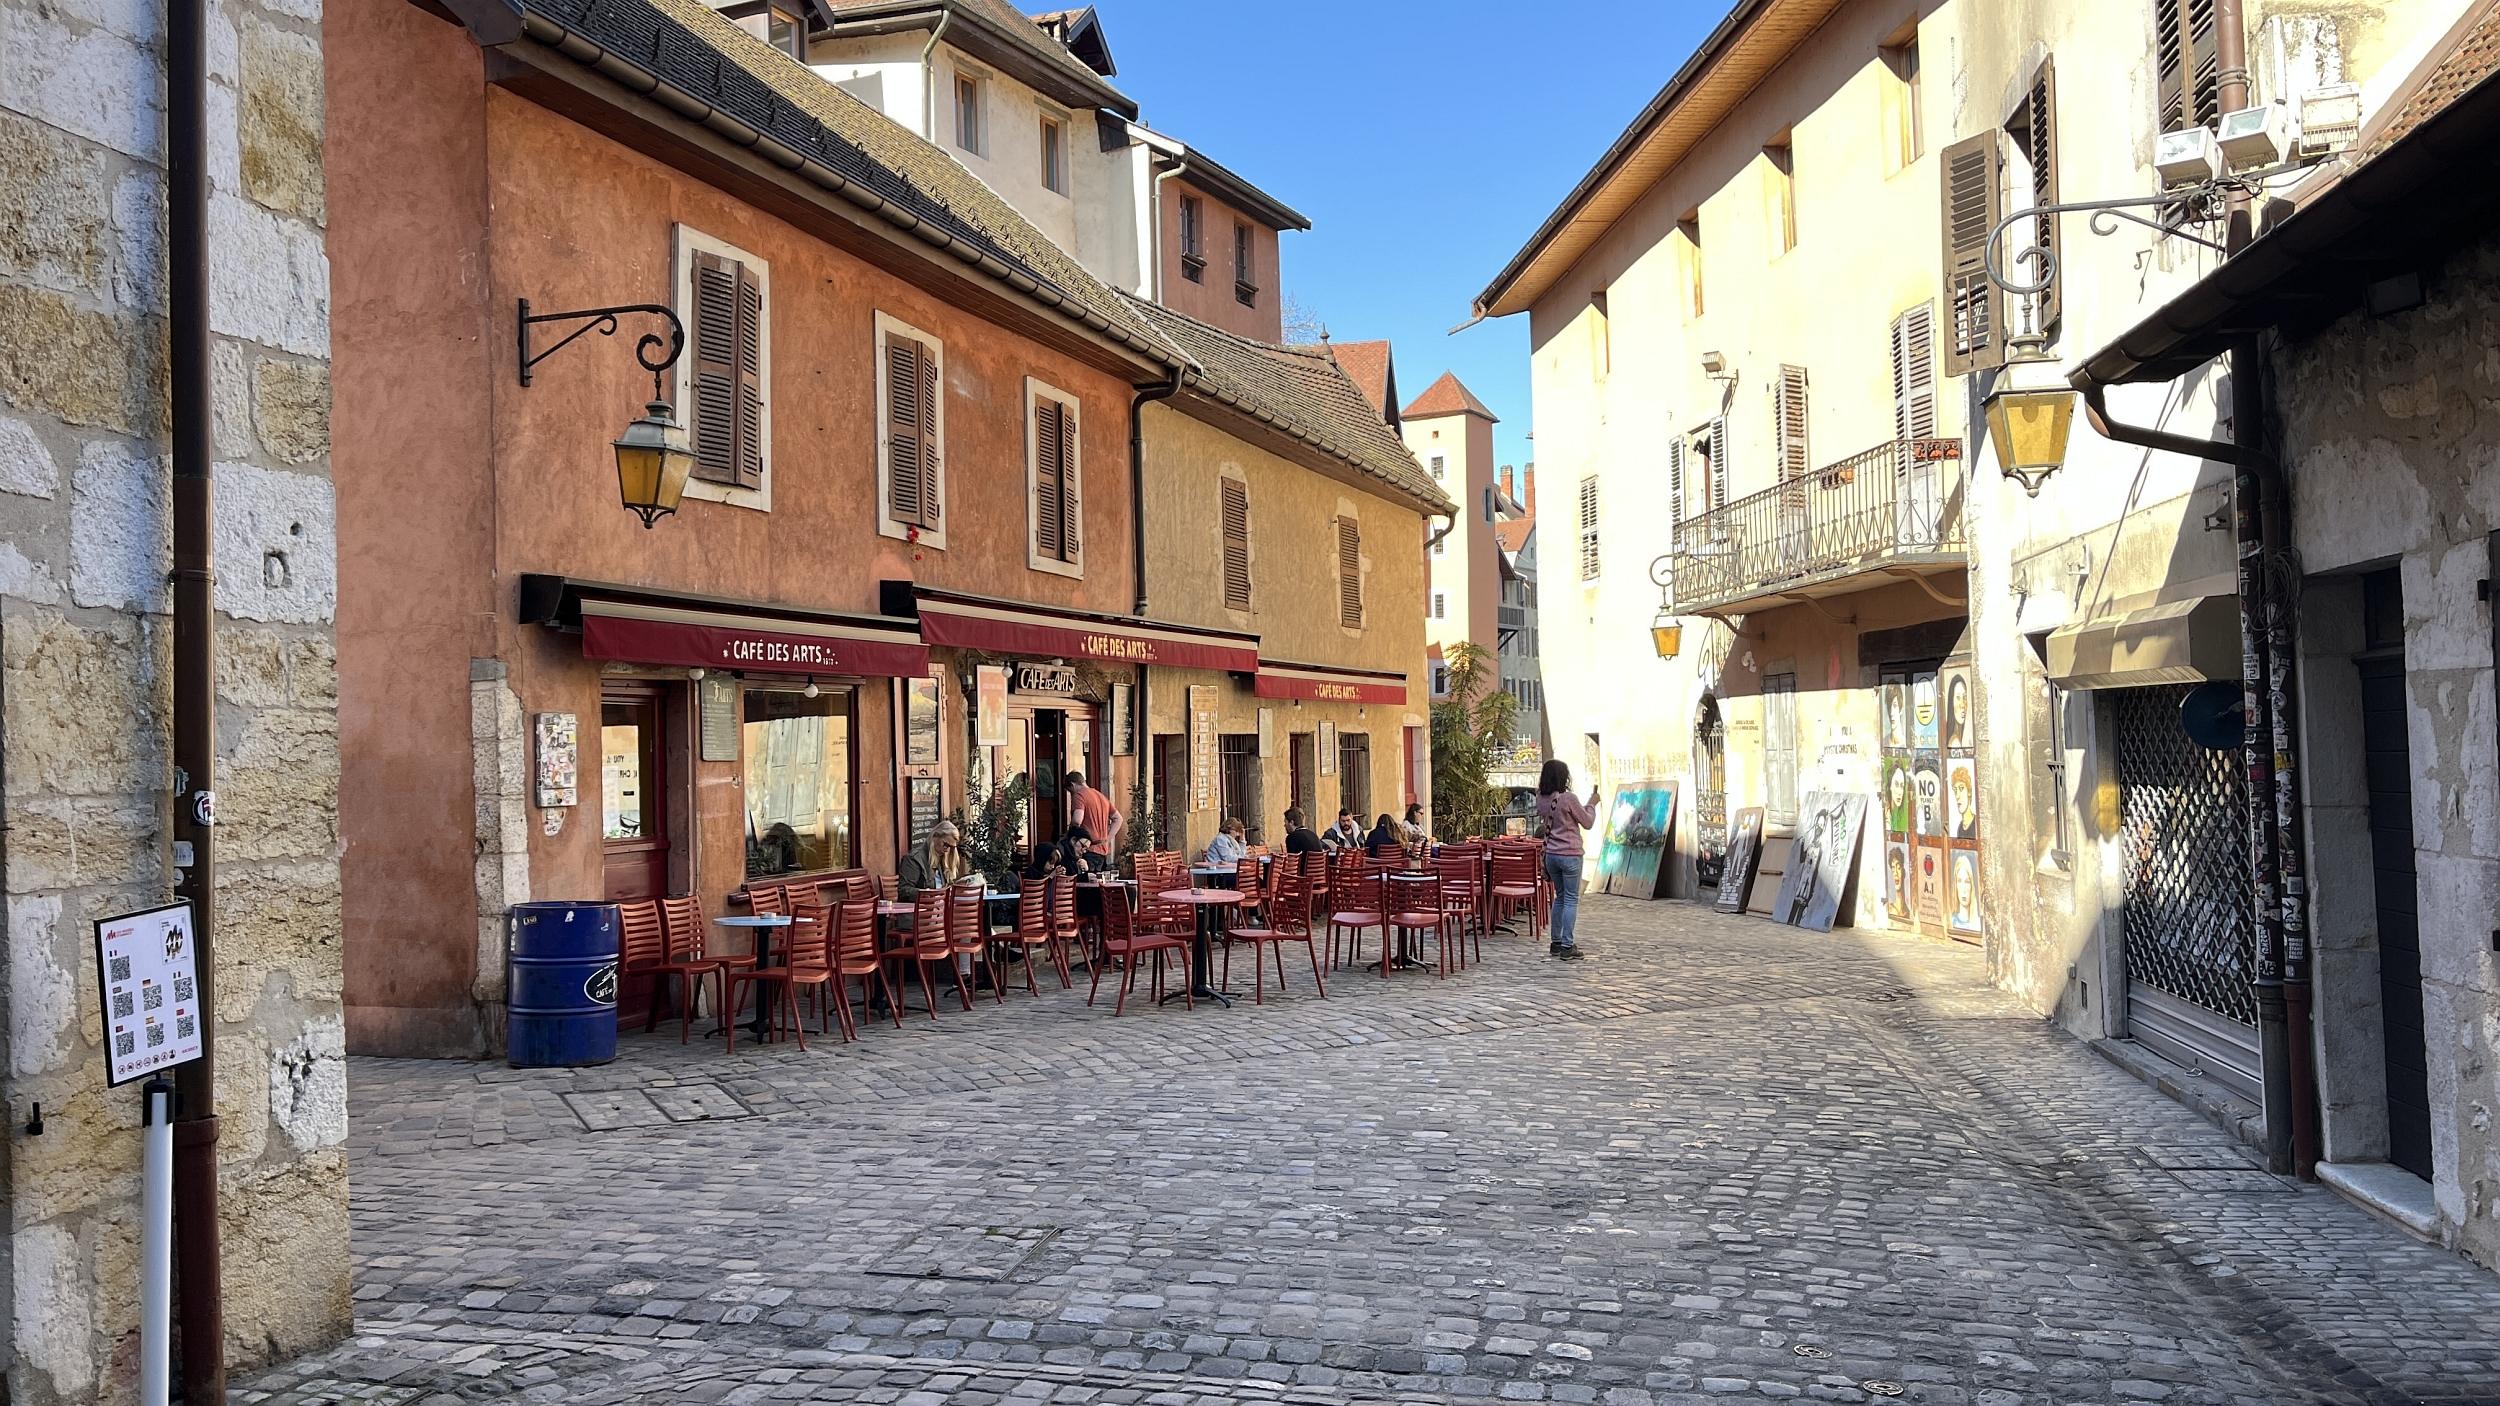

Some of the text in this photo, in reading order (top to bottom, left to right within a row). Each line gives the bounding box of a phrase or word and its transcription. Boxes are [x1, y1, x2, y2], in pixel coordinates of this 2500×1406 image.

[733, 638, 822, 664] CAFÉ DES ARTS
[1088, 635, 1147, 660] CAFÉ DES ARTS
[1053, 671, 1078, 692] ARTS
[1319, 682, 1355, 700] CAFÉ DES ARTS
[1918, 779, 1935, 798] NO
[1924, 805, 1932, 822] B
